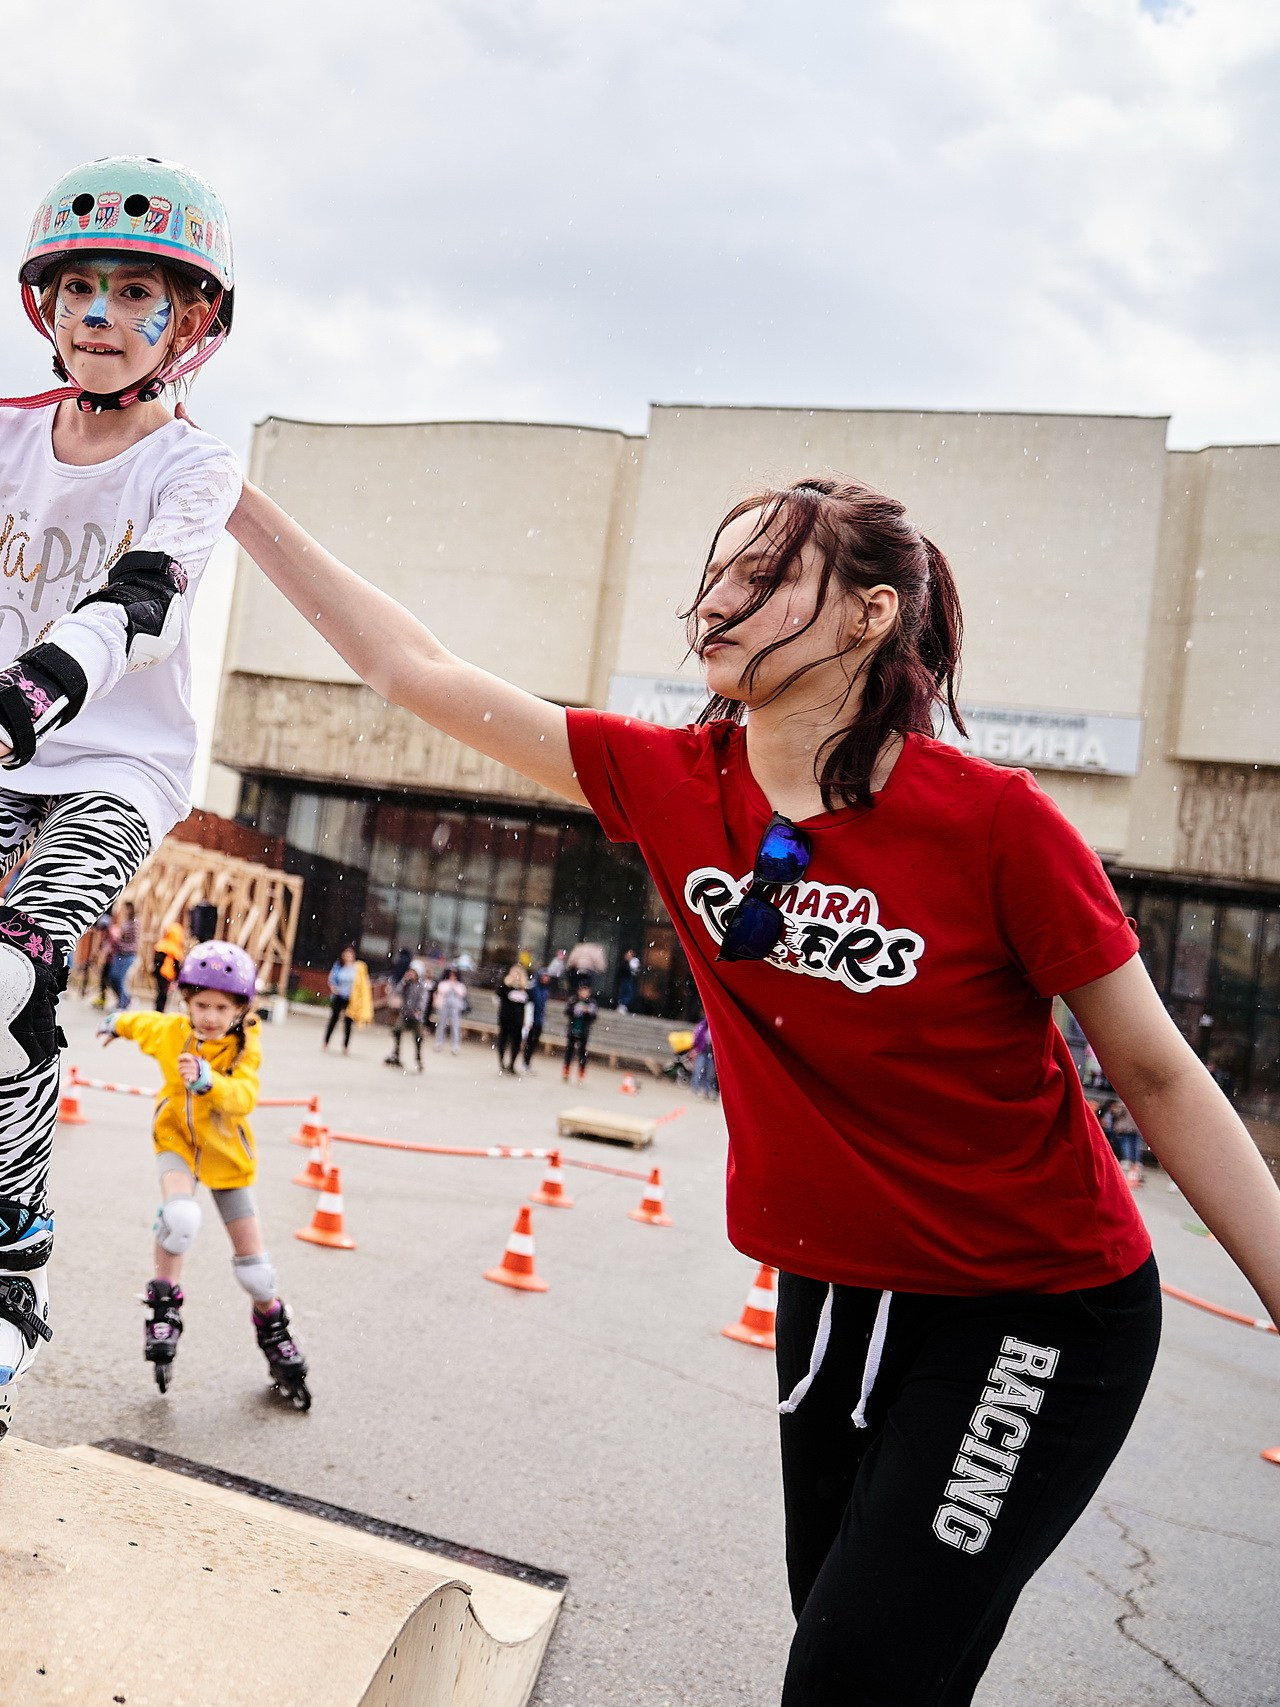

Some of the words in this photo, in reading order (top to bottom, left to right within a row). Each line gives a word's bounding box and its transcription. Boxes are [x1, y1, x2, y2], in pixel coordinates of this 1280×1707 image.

[690, 876, 917, 984] RERS
[740, 883, 871, 926] MARA
[932, 1336, 1061, 1555] RACING
